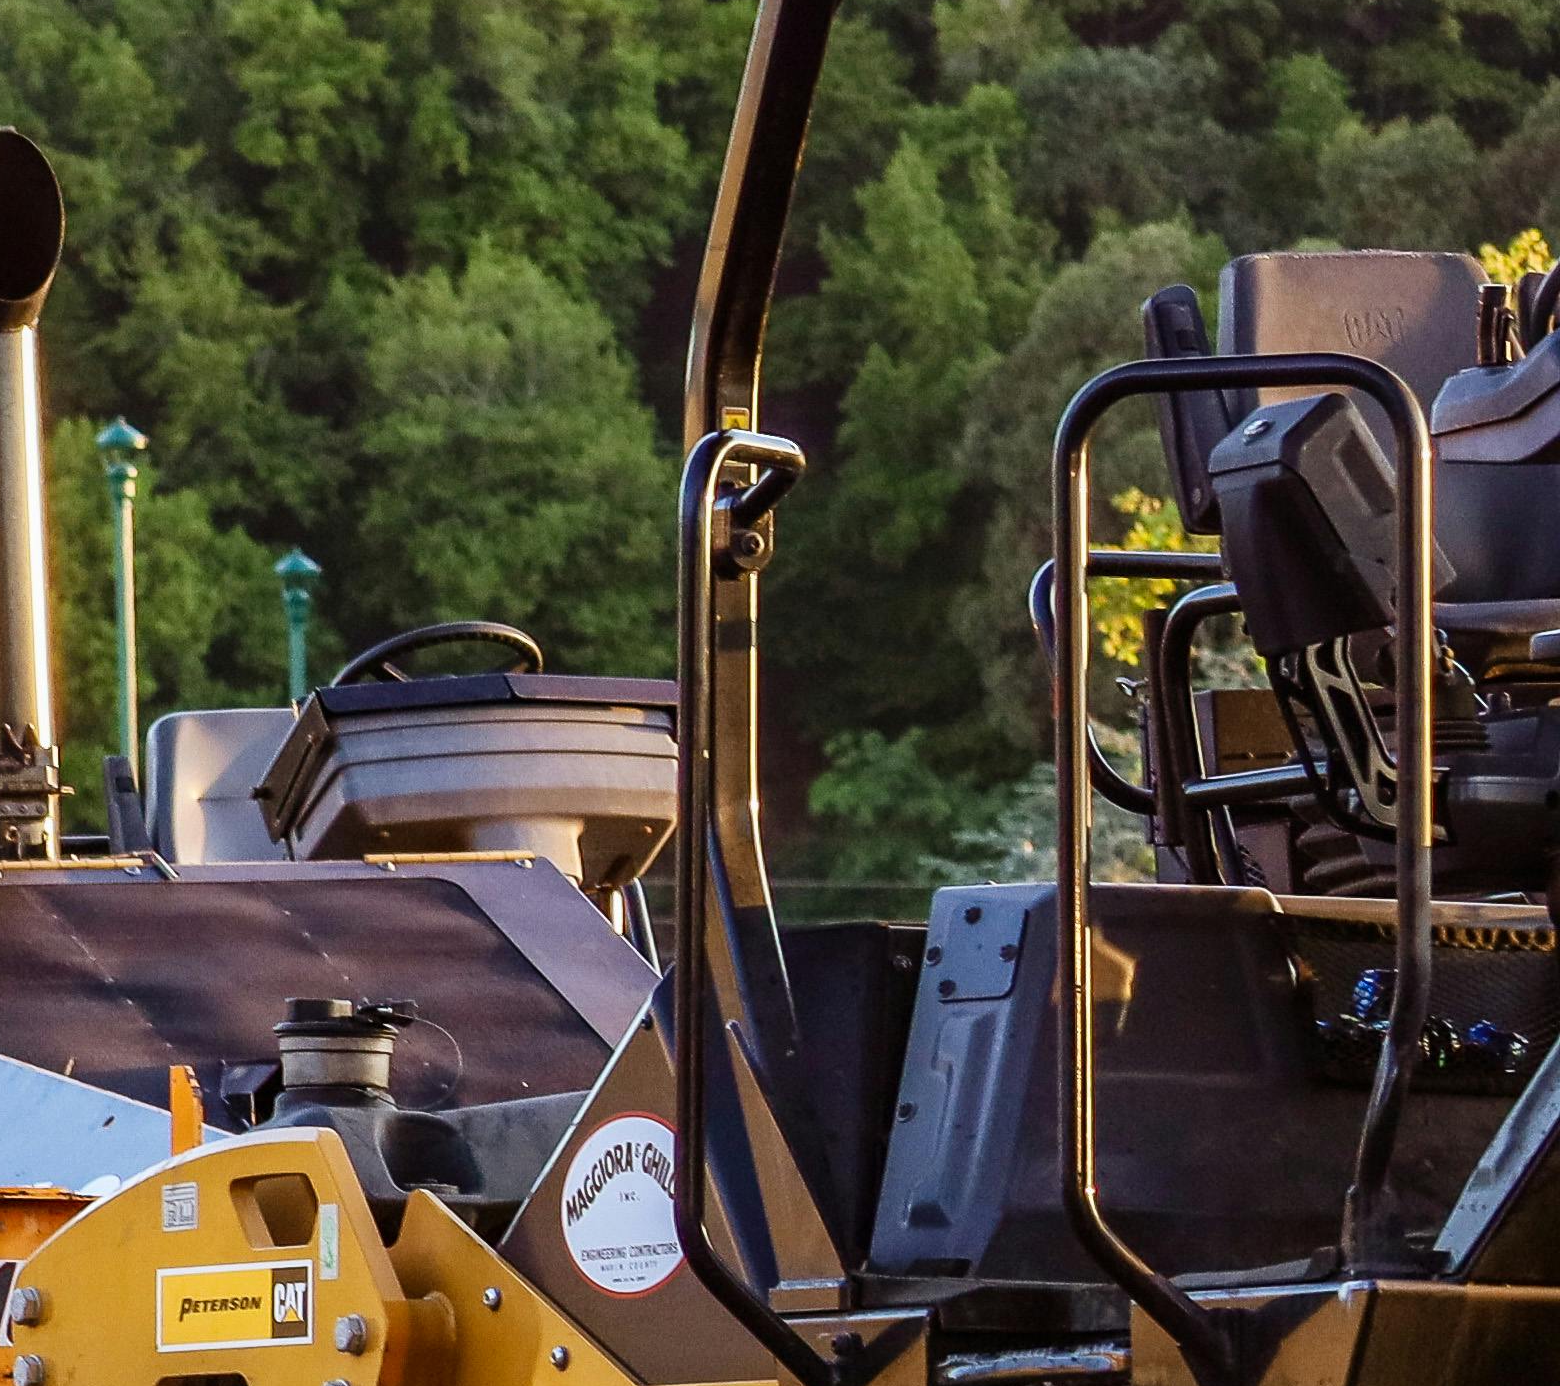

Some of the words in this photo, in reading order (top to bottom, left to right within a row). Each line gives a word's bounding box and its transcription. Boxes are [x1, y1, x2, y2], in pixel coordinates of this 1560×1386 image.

[565, 1142, 634, 1227] MAGGIORA
[581, 1246, 627, 1262] ENGINEERING
[629, 1241, 679, 1258] CONTRACTORS
[179, 1296, 262, 1322] PETERSON
[273, 1282, 307, 1323] CAT
